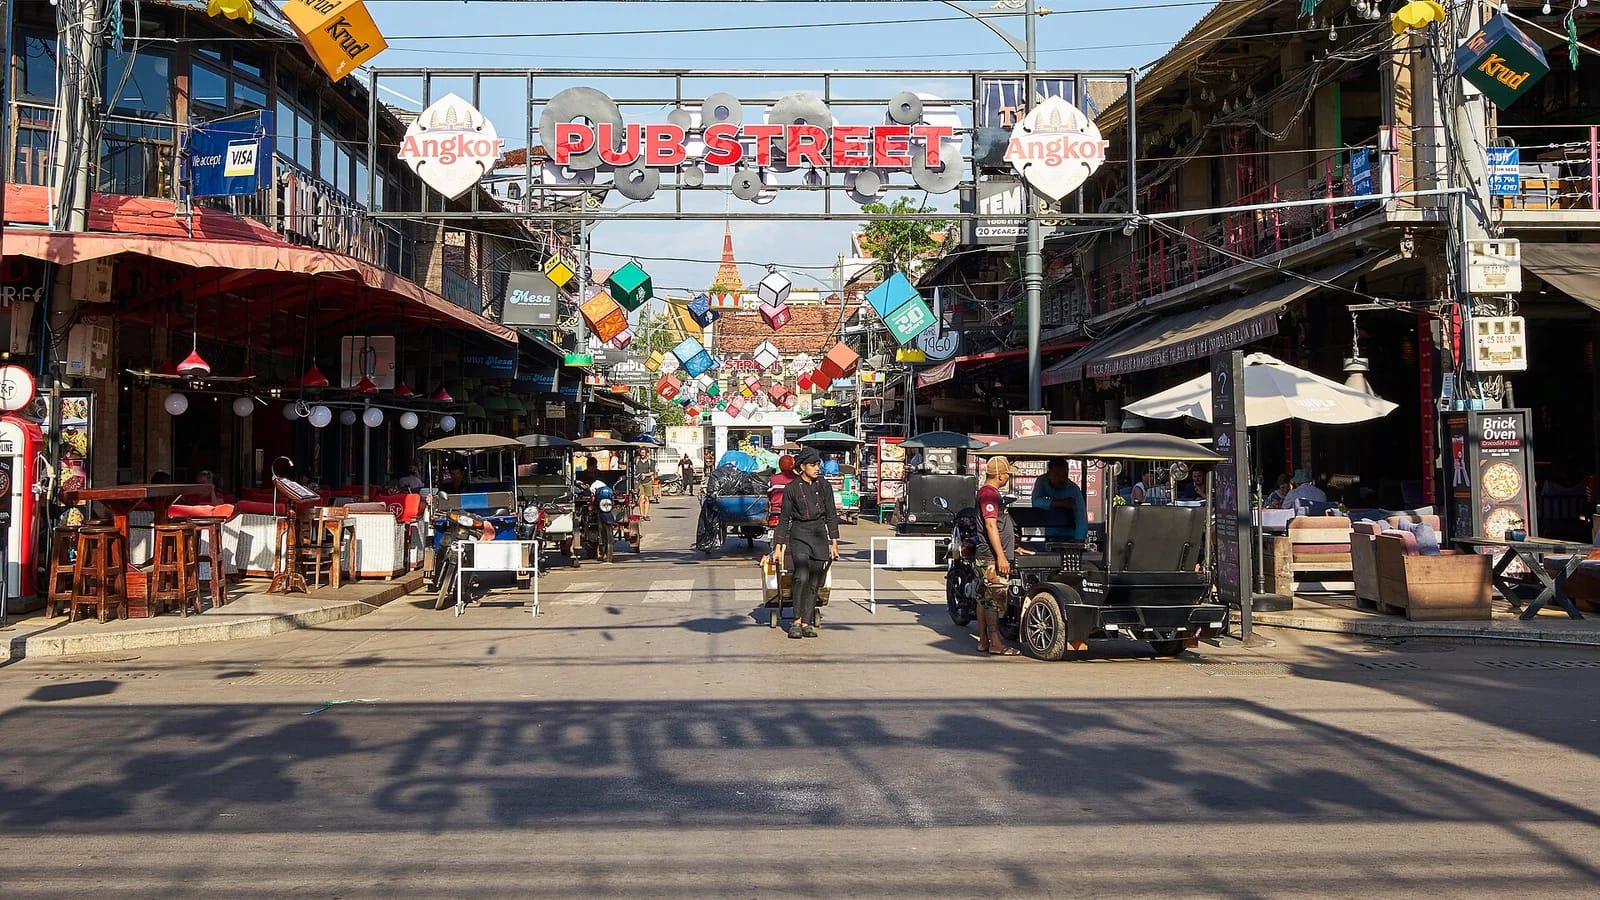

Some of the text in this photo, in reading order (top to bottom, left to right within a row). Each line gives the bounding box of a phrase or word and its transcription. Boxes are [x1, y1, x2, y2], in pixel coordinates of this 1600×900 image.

[324, 15, 370, 60] Krud
[1477, 53, 1531, 90] Krud
[398, 133, 503, 166] Angkor
[554, 122, 953, 168] PUB STREET
[1005, 135, 1109, 168] Angkor
[192, 154, 221, 168] We accept
[231, 150, 253, 166] VISA
[977, 227, 990, 236] 20
[509, 288, 552, 305] Mesa
[924, 336, 951, 353] 1960
[1483, 416, 1517, 430] Brick
[1483, 429, 1516, 440] Oven
[0, 443, 13, 452] LINE
